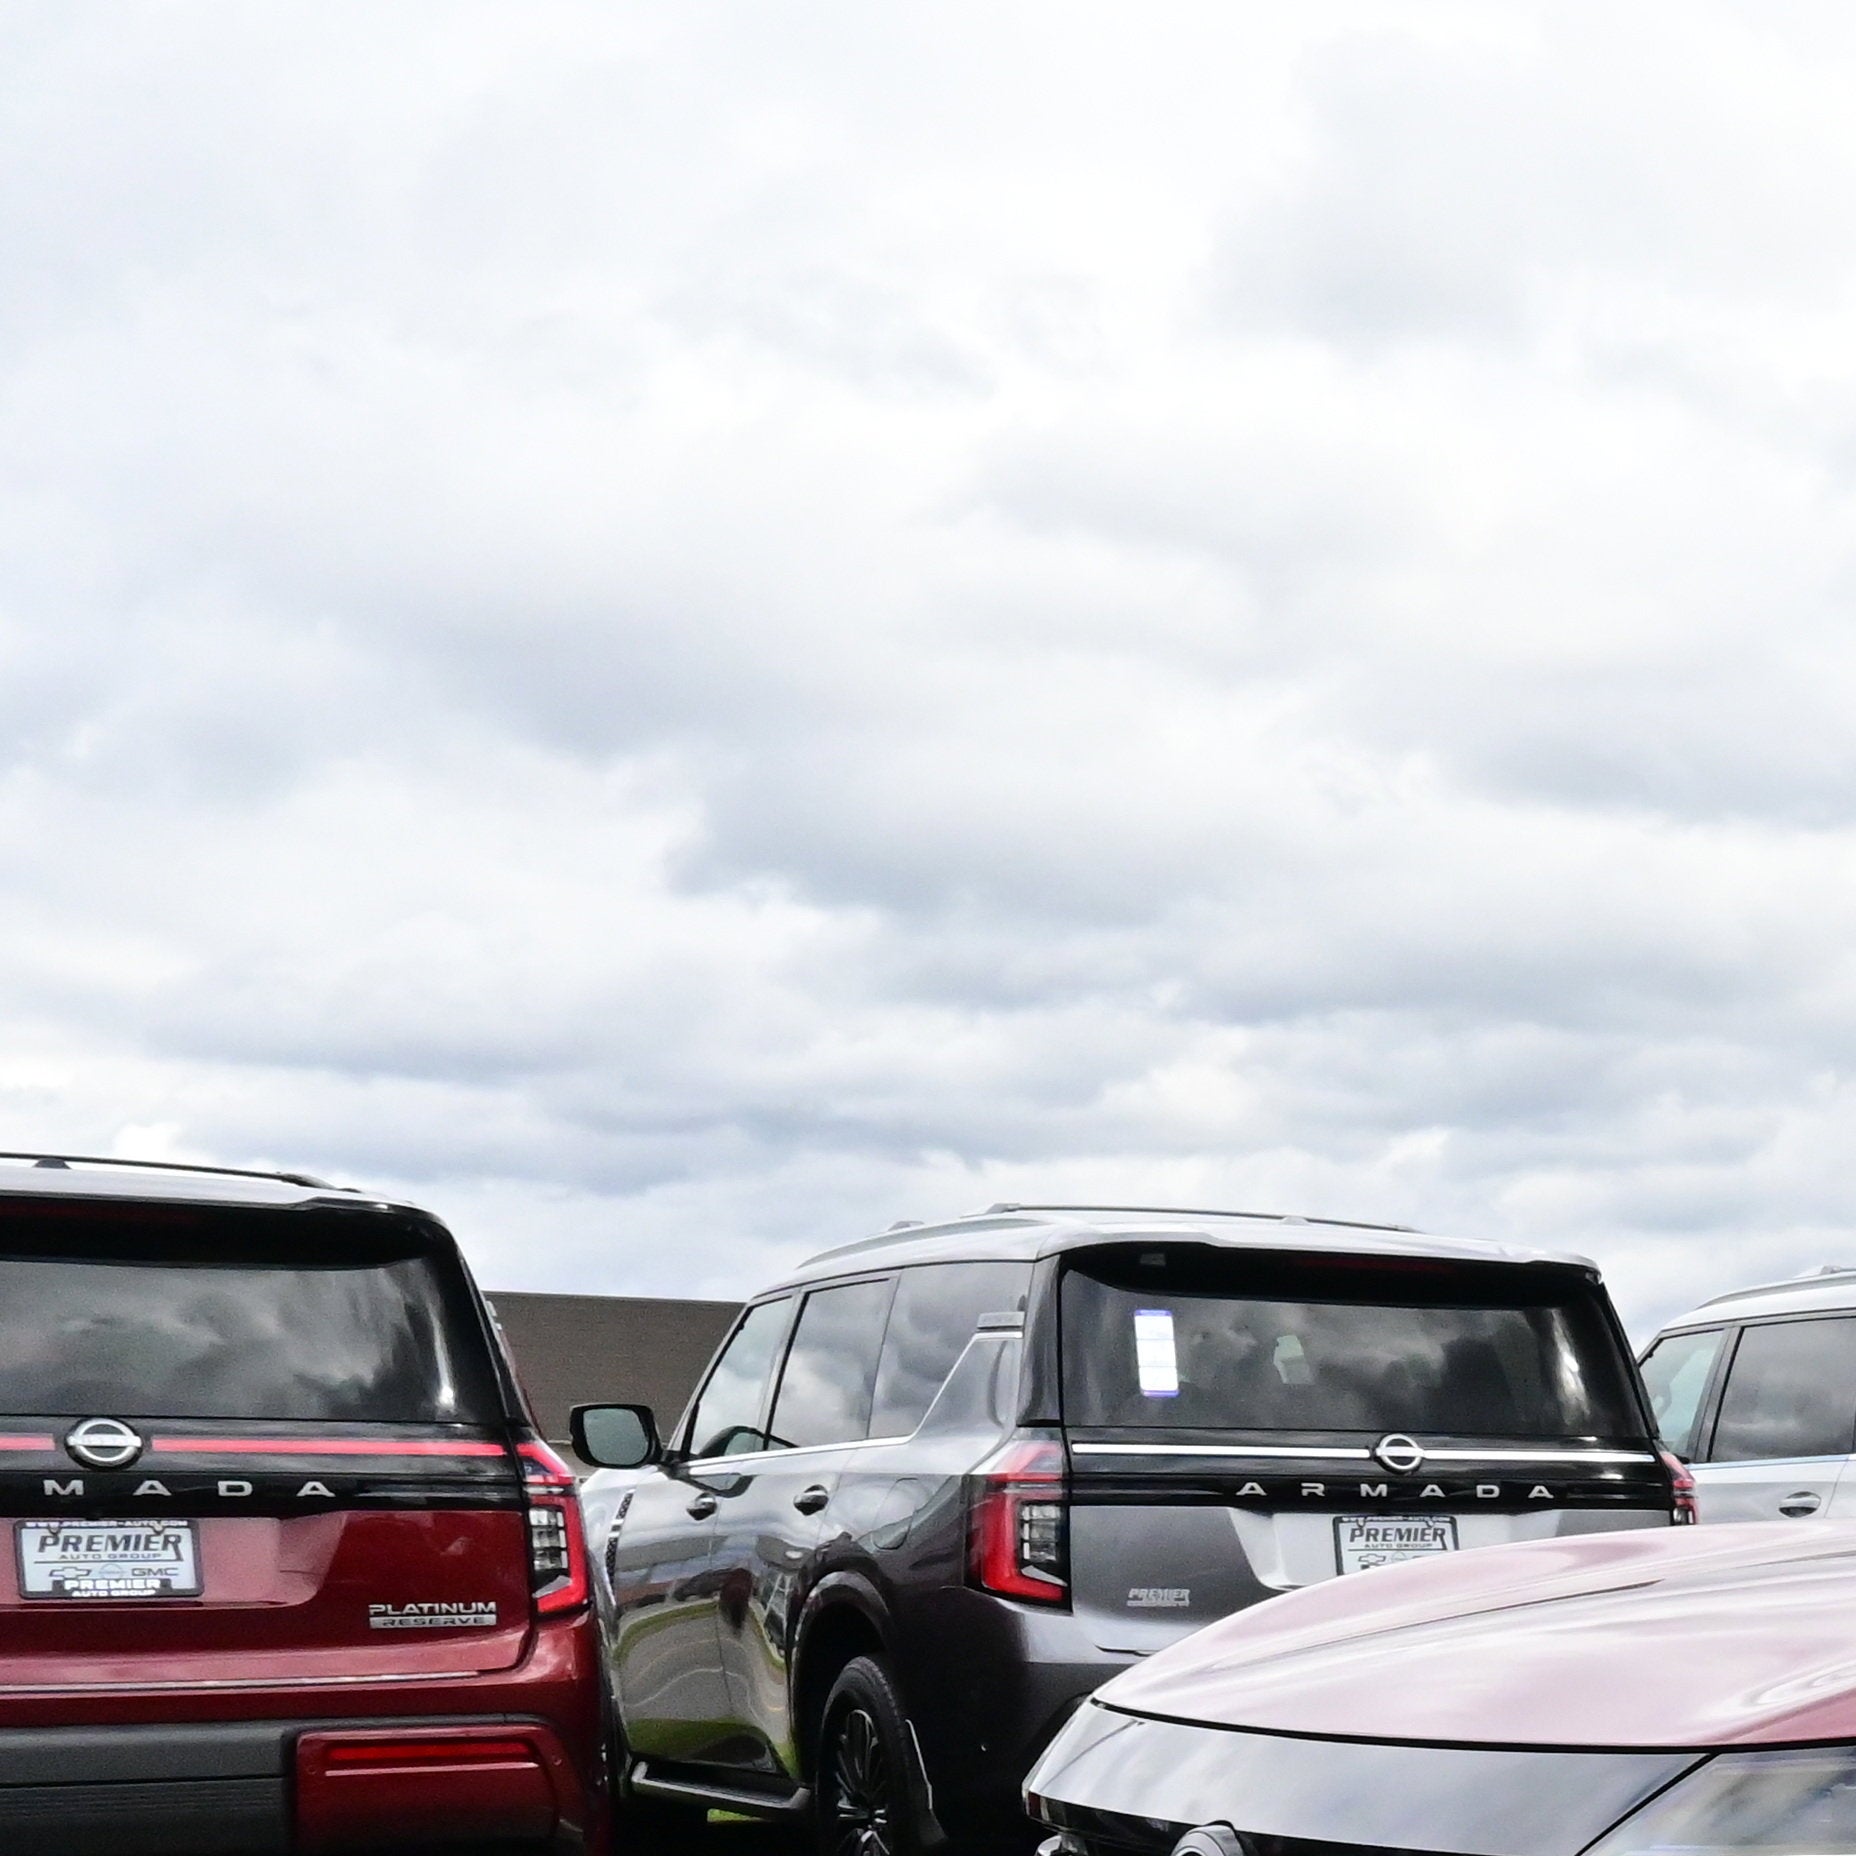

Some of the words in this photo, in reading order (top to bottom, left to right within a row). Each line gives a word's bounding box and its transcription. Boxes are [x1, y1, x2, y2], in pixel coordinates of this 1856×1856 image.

[1236, 1482, 1554, 1499] ARMADA
[1349, 1527, 1447, 1550] PREMIER
[38, 1534, 183, 1561] PREMIER
[131, 1568, 179, 1576] GMC
[63, 1579, 161, 1590] PREMIER
[368, 1601, 497, 1615] PLATINUM
[382, 1617, 485, 1626] RESERVE
